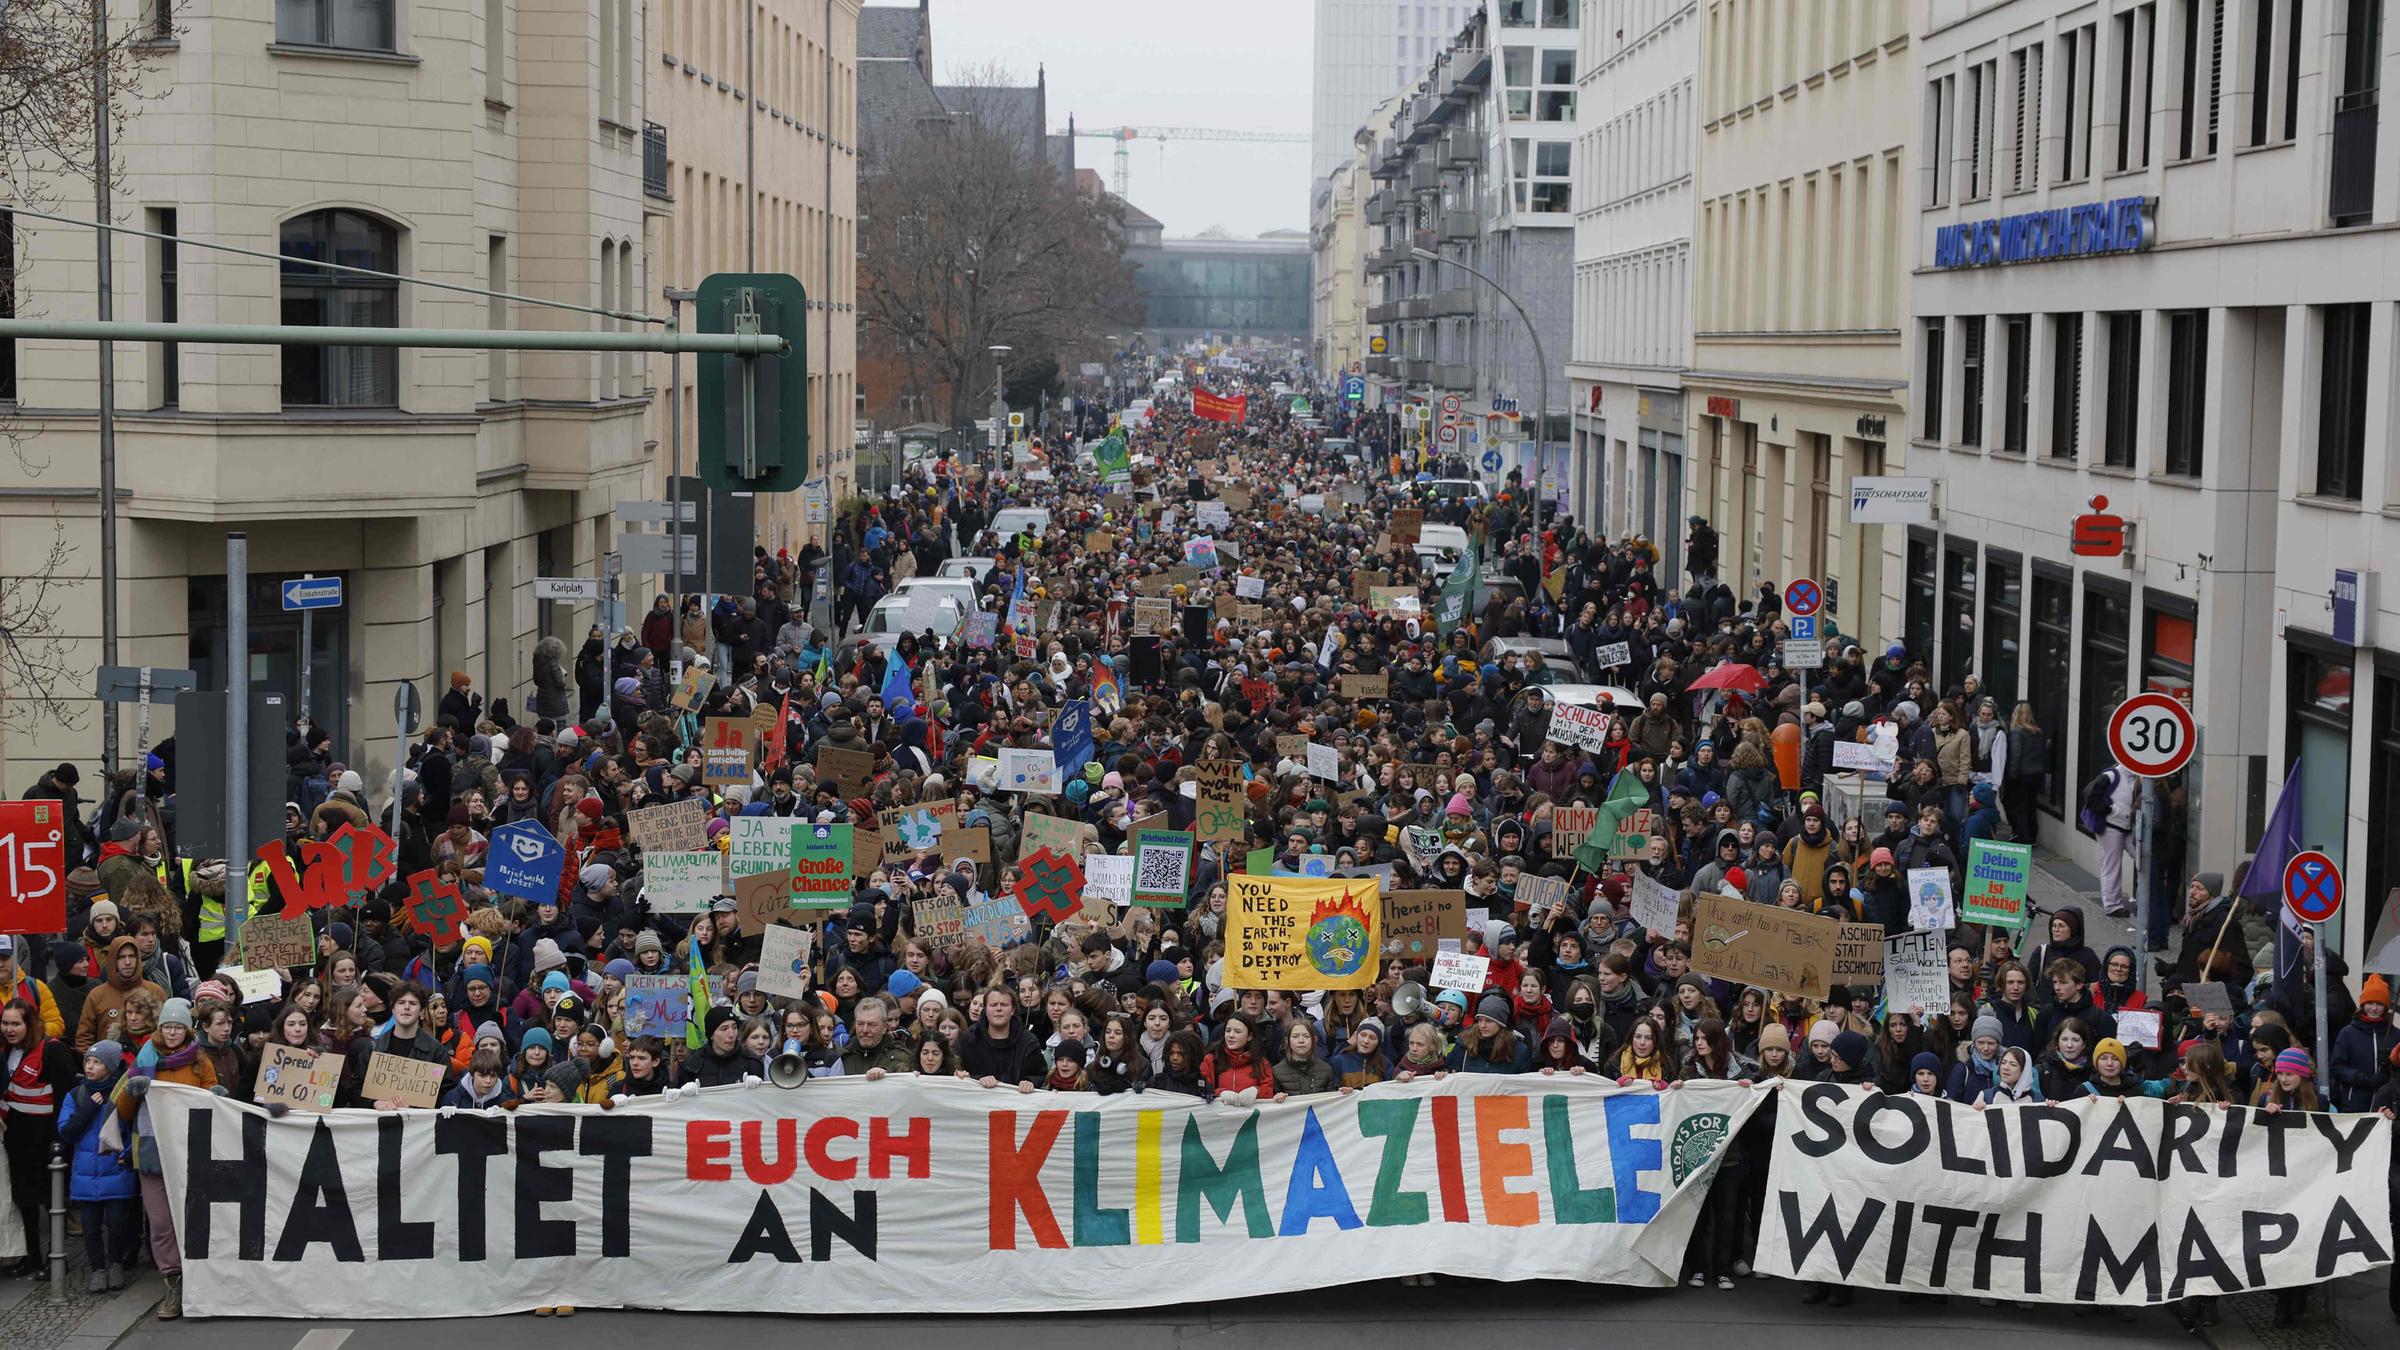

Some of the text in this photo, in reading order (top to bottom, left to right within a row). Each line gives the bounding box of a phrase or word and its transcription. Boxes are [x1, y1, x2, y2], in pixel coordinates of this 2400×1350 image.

[1935, 196, 2146, 267] HAUS DES WIRTSCHAFTSRATES
[1492, 394, 1519, 411] dm
[1854, 490, 1928, 498] WIRTSCHAFTSRAT
[299, 587, 339, 599] Einbahnstraße
[1795, 620, 1807, 636] P
[1554, 704, 1610, 732] SCHLUSS
[713, 720, 744, 749] Ja
[1555, 720, 1595, 737] MIT DER
[2127, 714, 2177, 755] 30
[1547, 727, 1601, 750] WACHSTUMSPARTY
[707, 748, 725, 757] zum
[708, 755, 746, 764] entscheid
[706, 764, 749, 778] 26.03.
[1201, 788, 1231, 803] Platz
[881, 811, 899, 826] WE
[740, 819, 764, 838] JA
[885, 840, 912, 855] HAVE
[647, 854, 718, 869] KLIMAPOLITIK
[798, 857, 844, 875] Große
[1093, 857, 1107, 869] THE
[1981, 851, 2018, 869] Deine
[498, 864, 545, 886] Briefwahl
[1093, 872, 1131, 885] WOULD HA
[1973, 865, 2023, 884] Stimme
[792, 875, 851, 893] Chance
[1237, 883, 1272, 897] YOU
[1515, 874, 1565, 907] GO VEGAN
[1988, 881, 2005, 895] ist
[936, 895, 957, 910] OUR
[1242, 897, 1289, 913] NEED
[1380, 896, 1452, 920] There is no
[1969, 894, 2022, 914] wichtig!
[1262, 915, 1296, 927] THIS
[1707, 899, 1779, 933] The earth has a
[918, 920, 961, 938] SO STOP
[1242, 927, 1292, 940] EARTH,
[1424, 915, 1441, 936] B!
[956, 932, 964, 944] IT
[1837, 927, 1883, 942] ASCHUTZ
[254, 942, 299, 957] EXPECT
[1242, 941, 1253, 951] SO
[1835, 943, 1866, 959] STATT
[247, 951, 315, 970] RESISTENCE
[1242, 954, 1302, 968] DESTROY
[1436, 958, 1461, 968] KOHLE
[1703, 951, 1745, 973] says the
[1916, 951, 1948, 968] Worte
[1260, 970, 1281, 981] IT
[1446, 967, 1482, 979] ZUKUNFT
[1921, 969, 1942, 977] haben
[632, 976, 688, 990] KEIN PLAS
[1438, 979, 1477, 991] KRAFTWERK
[650, 999, 689, 1022] Mee
[1925, 1001, 1951, 1013] HAND
[273, 1048, 315, 1070] Spread
[375, 1053, 429, 1078] THERE IS
[308, 1070, 340, 1090] LOVE
[371, 1071, 439, 1098] NO PLANET B
[266, 1084, 285, 1097] not
[1791, 1082, 2378, 1182] SOLIDARITY
[1673, 1126, 1691, 1182] RIDAYS
[1690, 1115, 1722, 1132] FOR
[988, 1093, 1662, 1250] KLIMAZIELE
[185, 1107, 932, 1263] HALTET EUCH
[727, 1188, 879, 1263] AN
[1778, 1189, 2394, 1303] WITH MAPA
